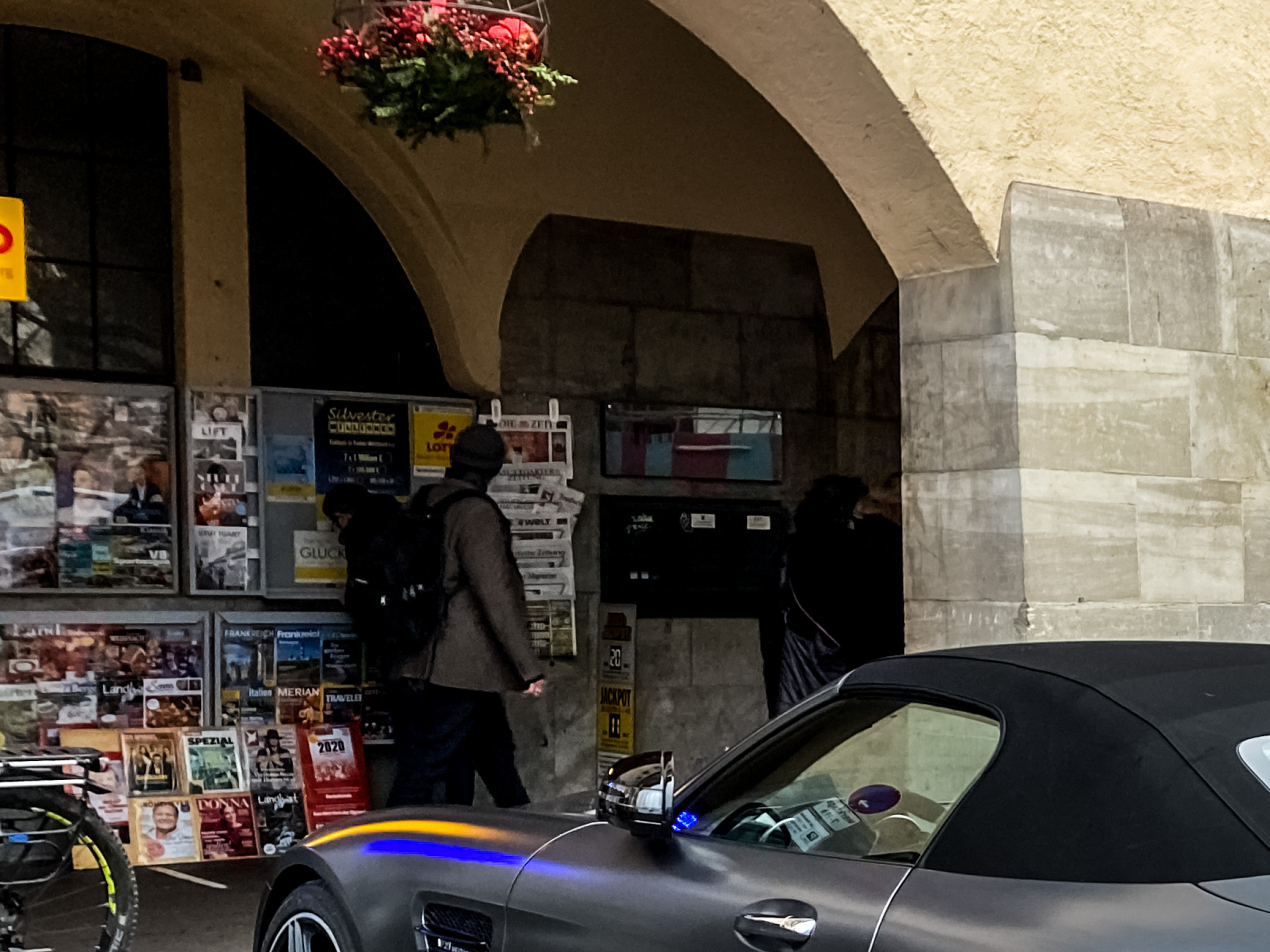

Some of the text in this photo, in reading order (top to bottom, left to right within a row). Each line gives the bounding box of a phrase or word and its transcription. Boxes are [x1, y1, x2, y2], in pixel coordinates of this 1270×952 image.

[328, 407, 395, 422] Silvester
[225, 629, 274, 639] FRANKREICH
[610, 648, 621, 667] 20
[248, 687, 272, 697] Italien
[277, 687, 320, 697] MERIAN
[600, 687, 631, 707] JACKPOT
[188, 736, 235, 748] SPEZIAL
[317, 740, 345, 754] 2020
[200, 797, 250, 811] DONNA
